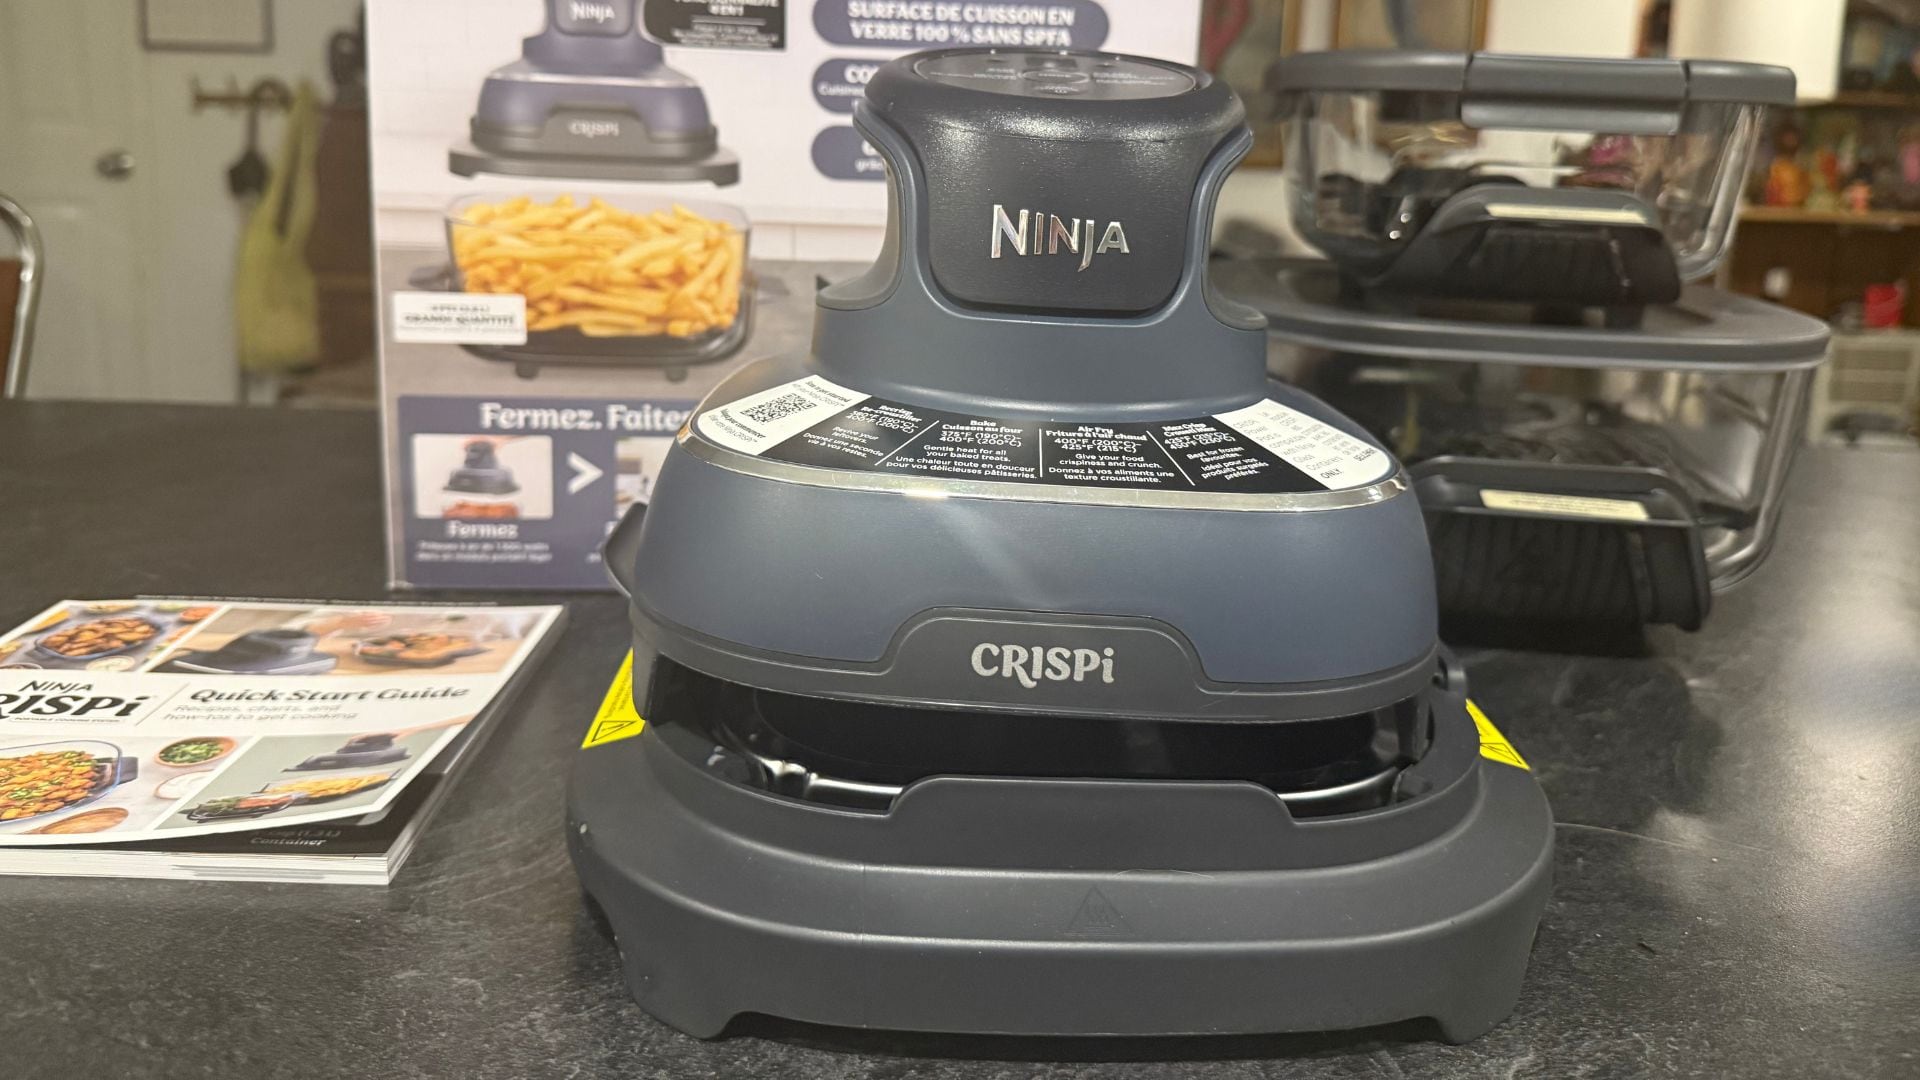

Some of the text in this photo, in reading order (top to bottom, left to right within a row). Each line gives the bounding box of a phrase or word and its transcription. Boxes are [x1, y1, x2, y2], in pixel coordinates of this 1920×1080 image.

[570, 2, 615, 23] NINJA
[847, 2, 1075, 26] SURFACE DE CUISSON EN
[850, 22, 1072, 46] VERRE 100 % SANS SPFA
[991, 204, 1130, 272] NINJA
[479, 402, 602, 430] Fermez.
[832, 426, 879, 441] Revive your
[942, 424, 985, 432] Cuisson
[999, 426, 1023, 434] four
[1046, 430, 1084, 438] Friture
[1114, 433, 1148, 441] chaud
[1095, 426, 1114, 435] Fry
[803, 432, 834, 442] Donnez
[849, 442, 884, 457] seconde
[939, 436, 1022, 448] 400°F (200°C)
[956, 446, 978, 454] heat
[1096, 445, 1137, 454] (215°C)
[1186, 452, 1207, 460] Best
[1217, 446, 1245, 454] frozen
[950, 451, 979, 460] baked
[981, 454, 1011, 462] treats.
[916, 458, 951, 466] chaleur
[953, 460, 979, 468] toute
[995, 463, 1036, 472] douceur
[1059, 459, 1106, 467] crispiness
[1127, 461, 1163, 469] crunch.
[1201, 462, 1223, 472] Idéal
[1223, 460, 1242, 468] pour
[1201, 461, 1269, 479] produits surgelés
[929, 463, 982, 475] délicieuses
[984, 468, 1037, 479] pâtisseries.
[1114, 469, 1155, 477] aliments
[1064, 473, 1162, 483] texture croustillante.
[446, 520, 519, 539] Fermez
[972, 642, 1115, 689] CRISPi
[18, 680, 93, 693] NINJA
[190, 687, 470, 702] Quick Start Guide
[175, 704, 341, 712] Recipes, charts, and
[257, 713, 287, 721] get
[290, 712, 359, 720] cooking
[250, 837, 327, 845] Container
